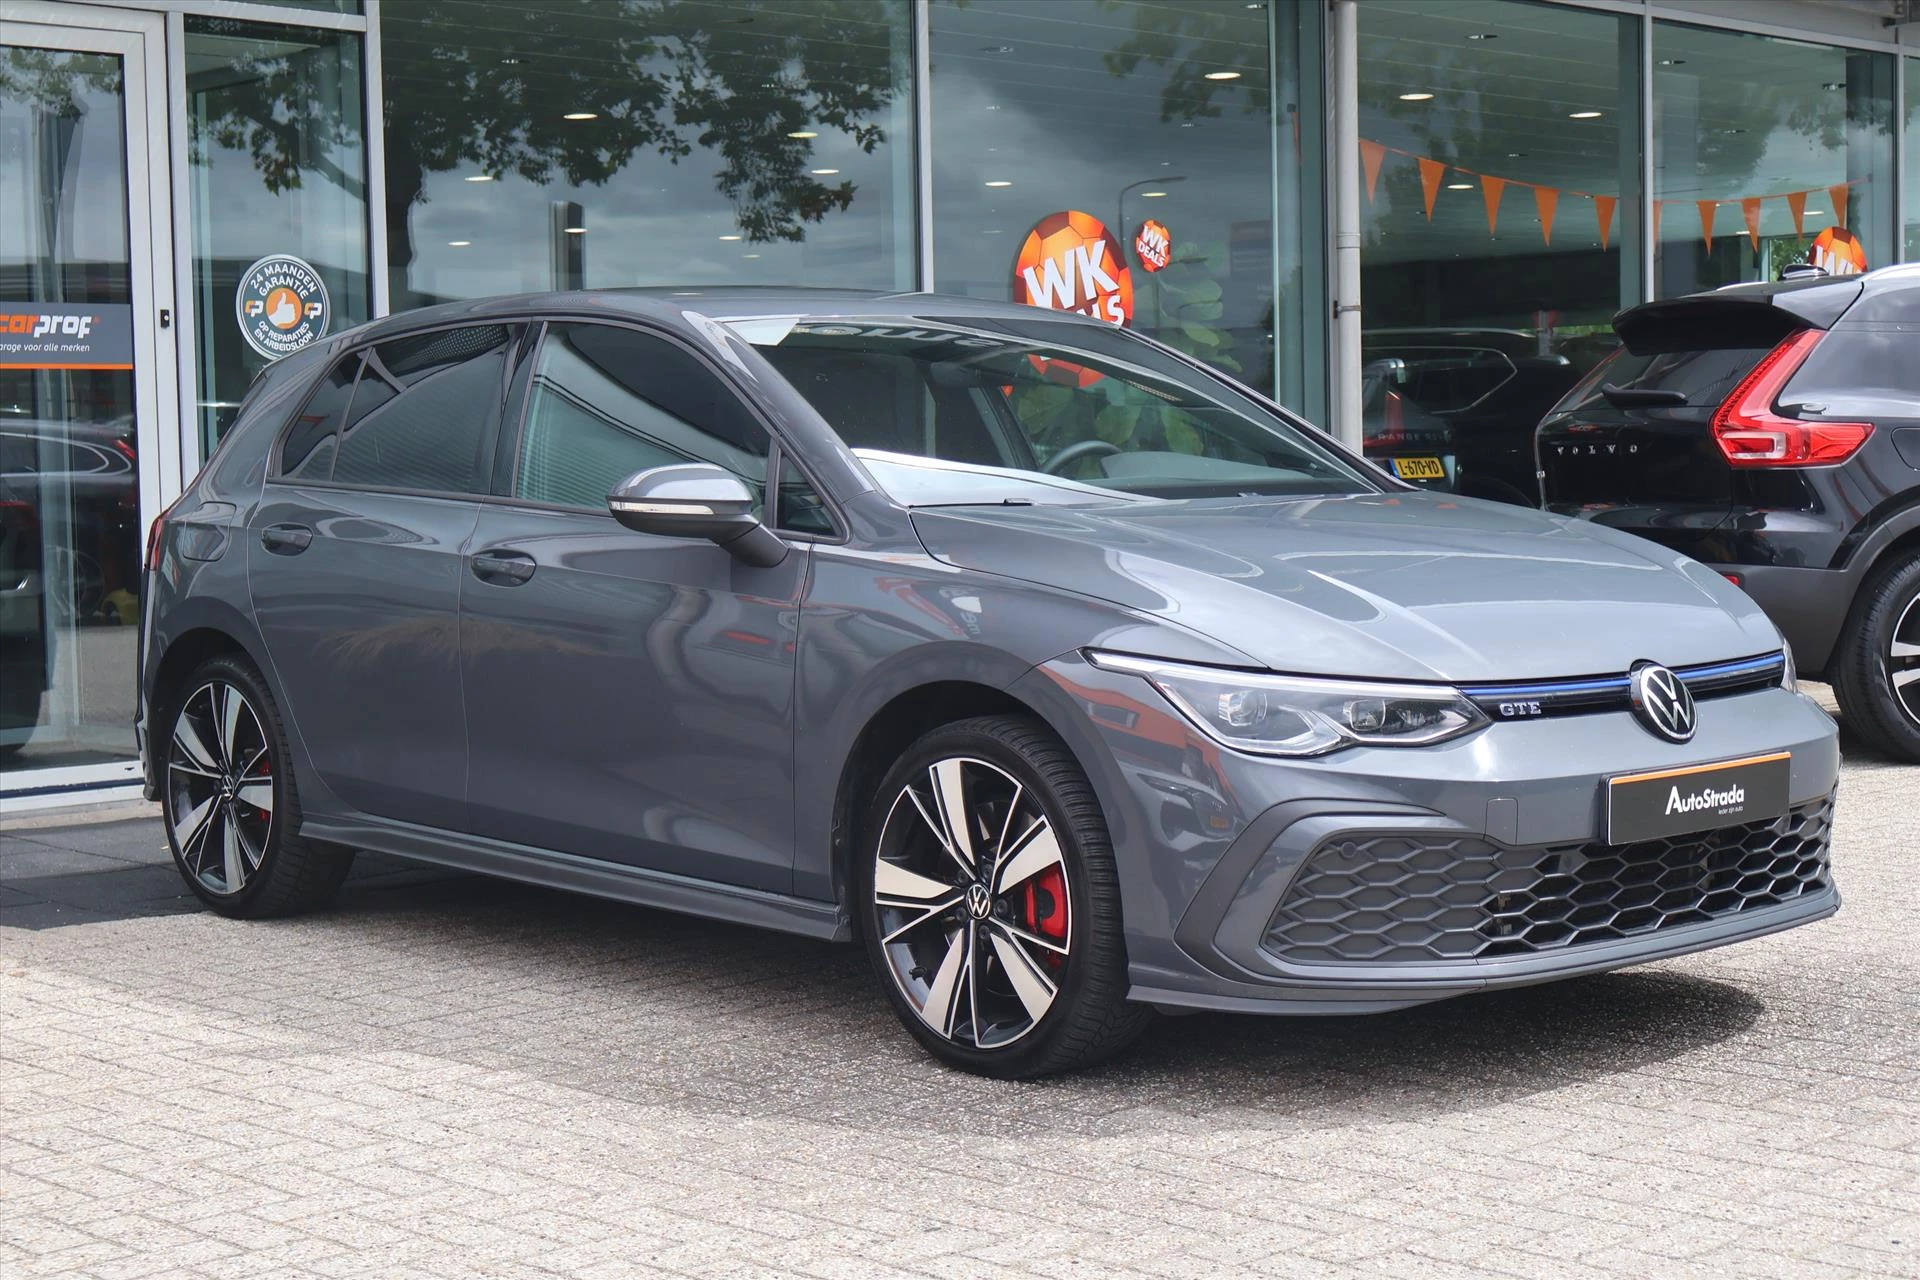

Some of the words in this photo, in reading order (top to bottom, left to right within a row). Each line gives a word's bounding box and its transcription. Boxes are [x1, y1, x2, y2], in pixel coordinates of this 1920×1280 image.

[1138, 240, 1166, 267] DEALS
[1143, 225, 1169, 257] WK
[251, 273, 264, 289] 24
[264, 264, 317, 293] MAANDEN
[1023, 240, 1120, 309] WK
[259, 275, 309, 300] GARANTIE
[0, 314, 92, 339] carprof
[258, 320, 269, 332] OP
[268, 321, 310, 343] REPARATIES
[24, 343, 42, 352] voor
[44, 342, 58, 352] alle
[61, 343, 90, 352] merken
[254, 328, 265, 341] EN
[264, 330, 314, 352] ARBEIDSLOON
[1557, 444, 1638, 456] VOLVO
[1500, 702, 1542, 716] GTE
[1665, 783, 1745, 815] AutoStrada
